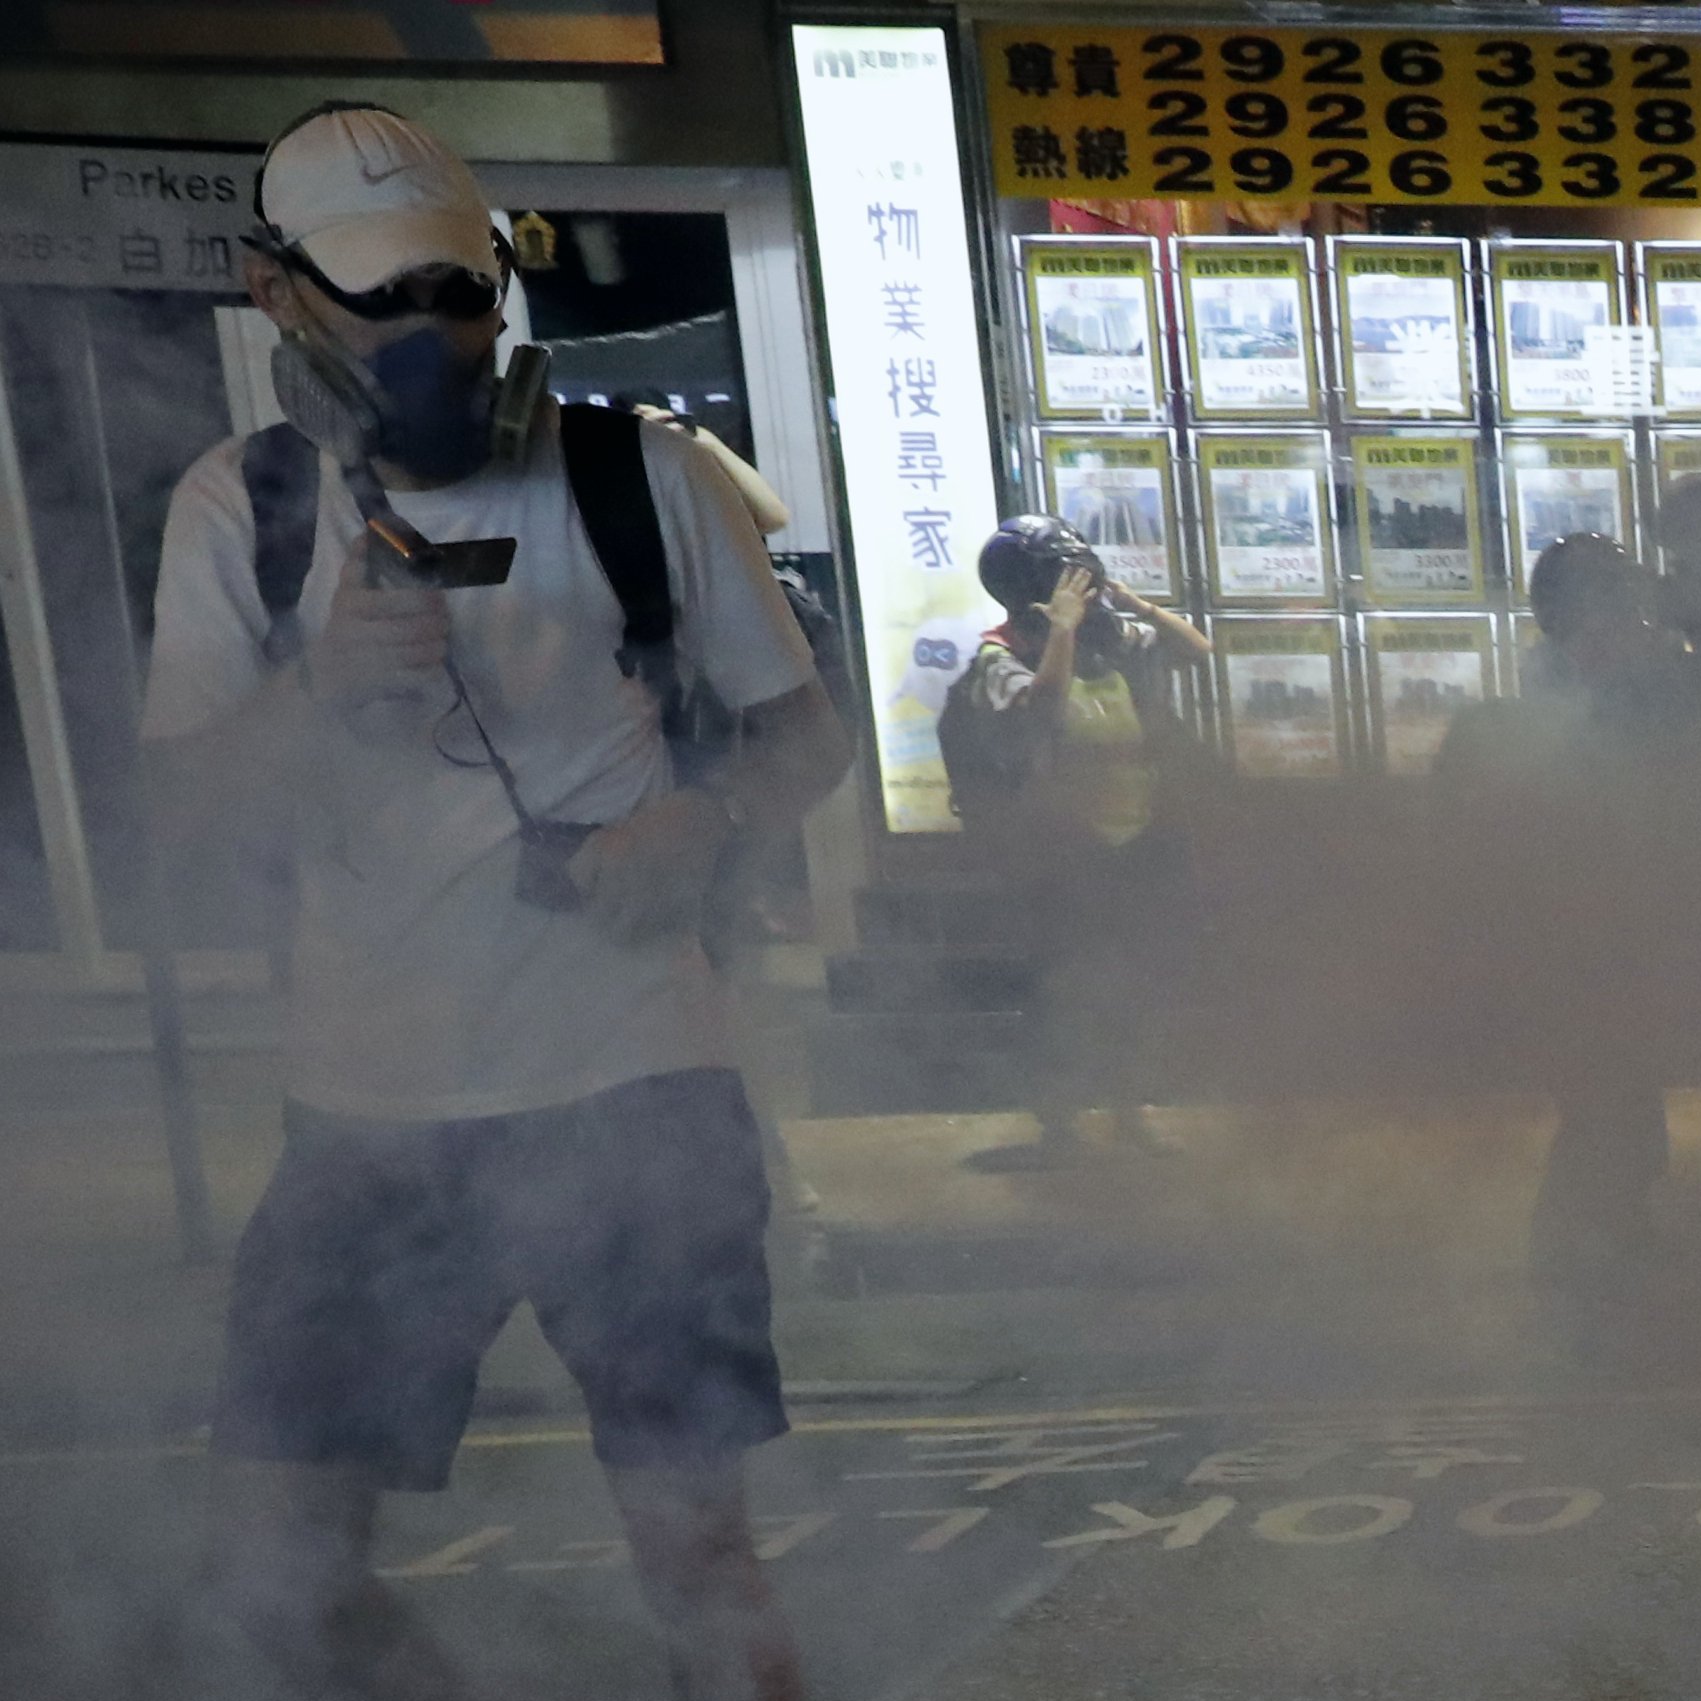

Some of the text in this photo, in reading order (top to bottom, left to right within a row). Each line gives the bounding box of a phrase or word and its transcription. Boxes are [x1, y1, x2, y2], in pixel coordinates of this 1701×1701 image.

[1003, 42, 1121, 98] 尊貴
[1142, 33, 1444, 84] 2926
[1147, 91, 1448, 141] 2926
[1012, 125, 1129, 180] 熱線
[1153, 147, 1452, 196] 2926
[79, 158, 237, 202] Parkes
